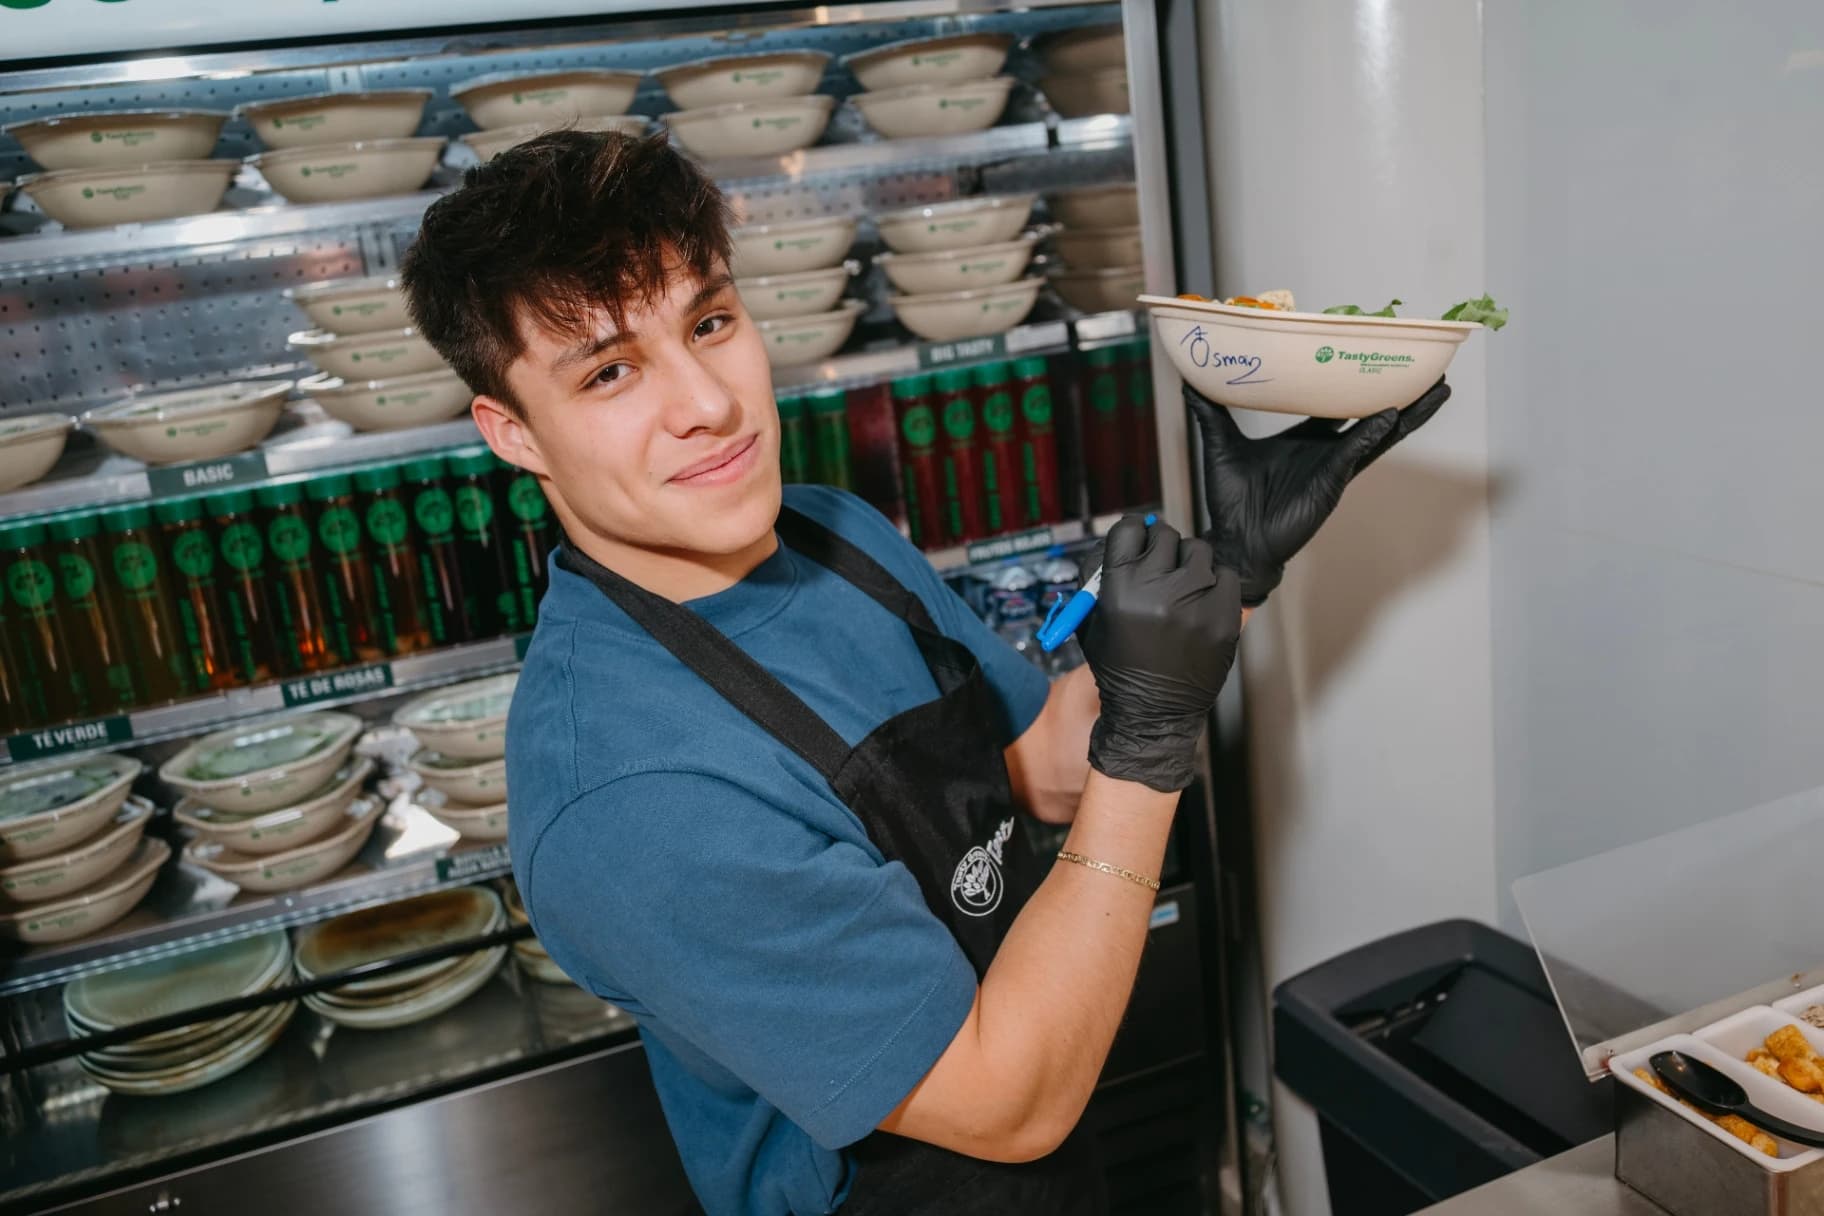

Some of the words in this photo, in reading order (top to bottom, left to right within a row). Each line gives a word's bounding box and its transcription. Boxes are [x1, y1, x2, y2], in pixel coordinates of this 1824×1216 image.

[183, 463, 234, 487] BASIC
[310, 677, 332, 696] DE
[333, 667, 385, 690] ROSAS
[53, 721, 108, 745] VERDE
